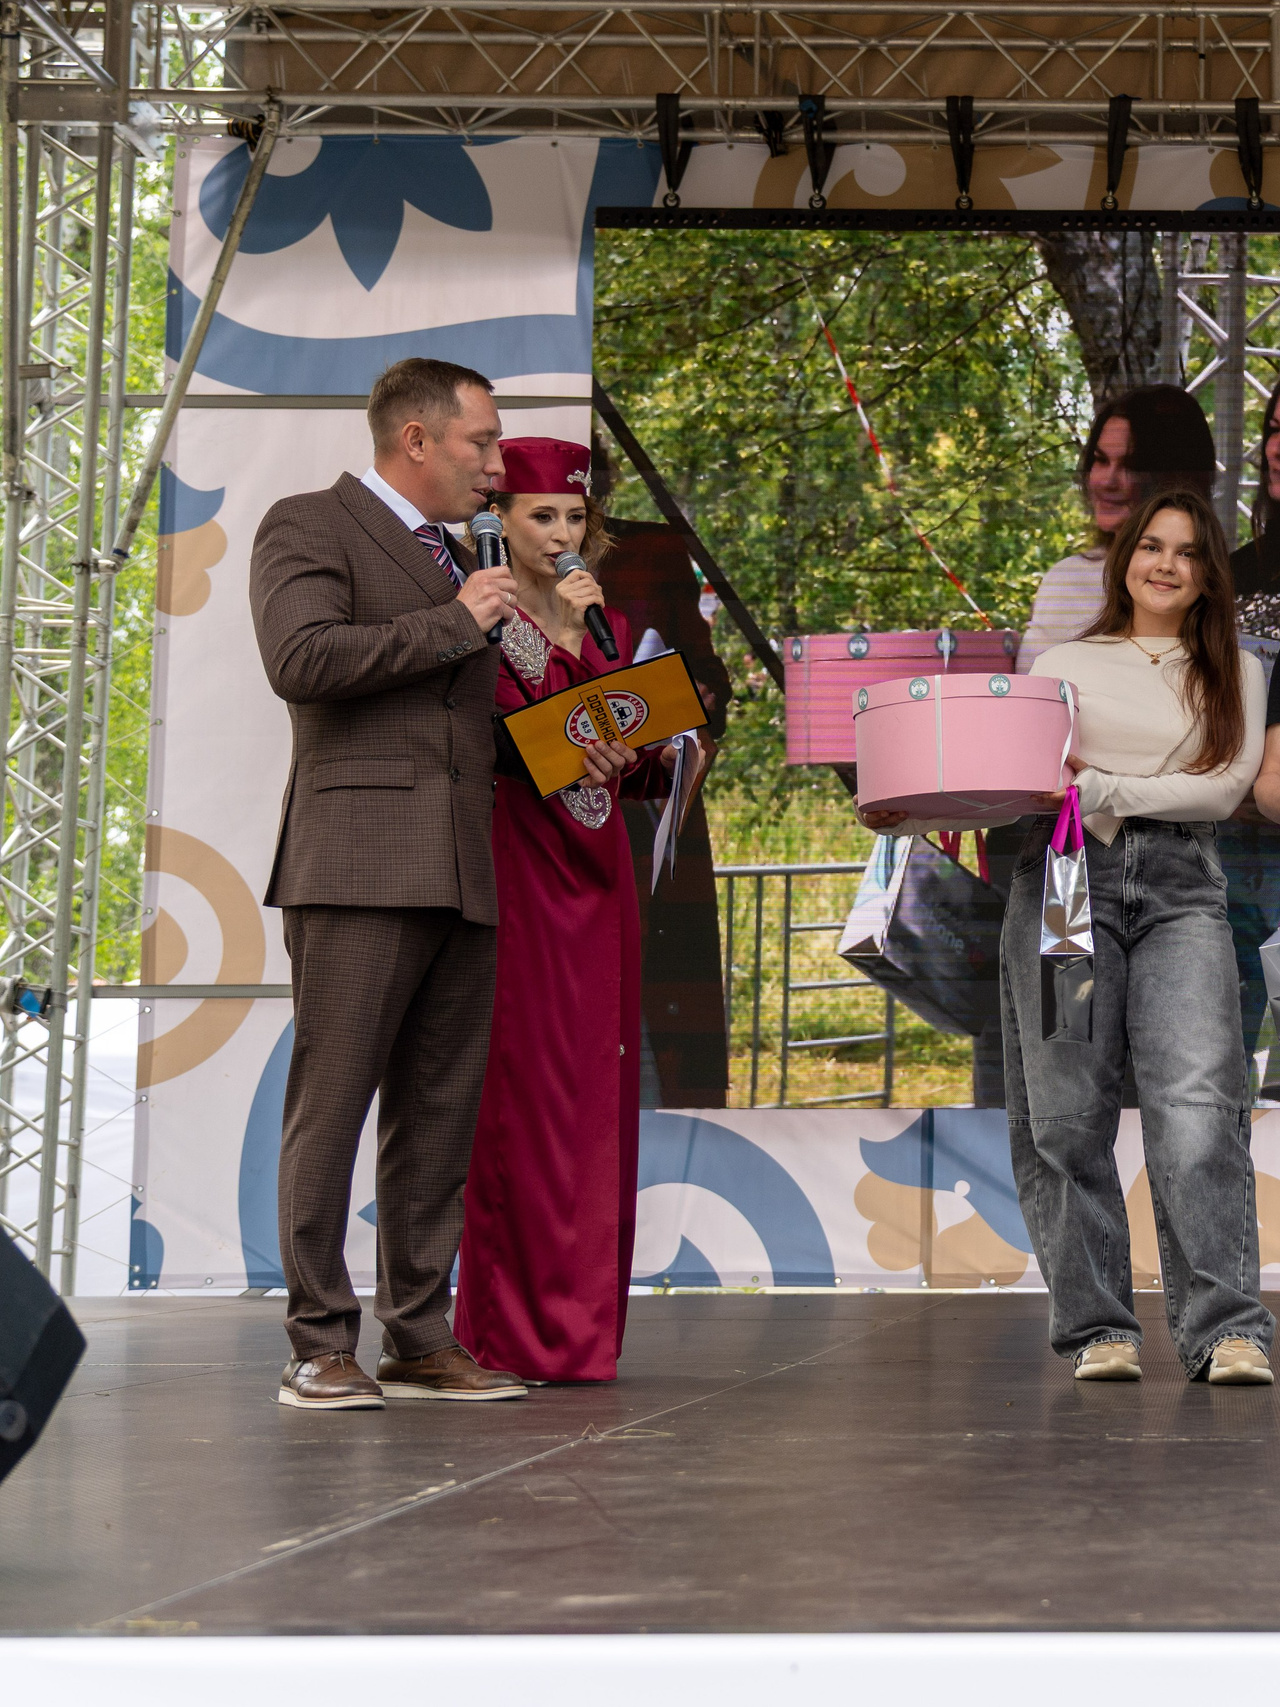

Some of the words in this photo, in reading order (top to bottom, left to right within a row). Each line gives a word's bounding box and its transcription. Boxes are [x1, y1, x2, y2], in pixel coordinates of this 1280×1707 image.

[627, 696, 644, 721] КАЗАНЬ
[570, 714, 591, 744] РАДИО
[580, 720, 592, 734] 88.9
